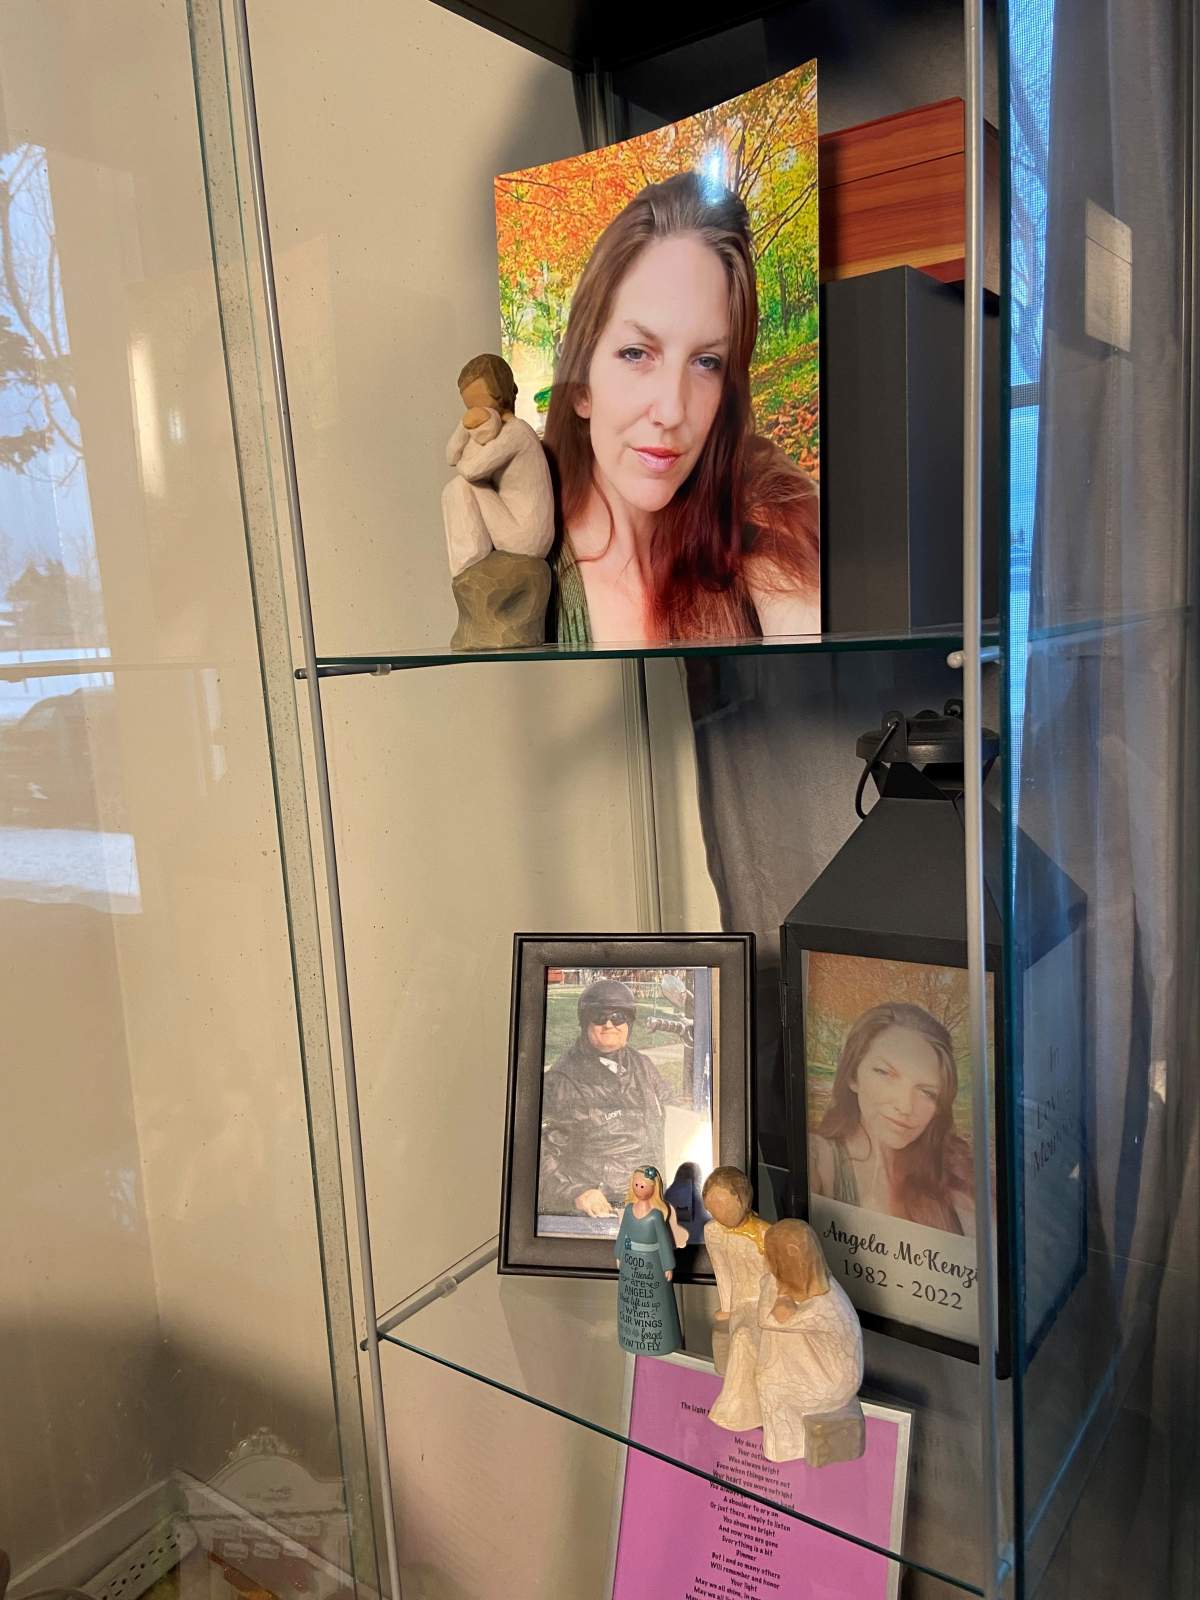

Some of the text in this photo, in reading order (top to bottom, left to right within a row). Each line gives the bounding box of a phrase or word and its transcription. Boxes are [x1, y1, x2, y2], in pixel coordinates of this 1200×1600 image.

[823, 1220, 889, 1257] Angela
[624, 1253, 645, 1268] GOOD
[624, 1284, 654, 1298] ANGELS
[843, 1259, 888, 1288] 1982
[911, 1280, 963, 1310] 2022
[634, 1319, 663, 1329] WINGS
[636, 1341, 646, 1350] TO
[647, 1342, 661, 1352] FLY
